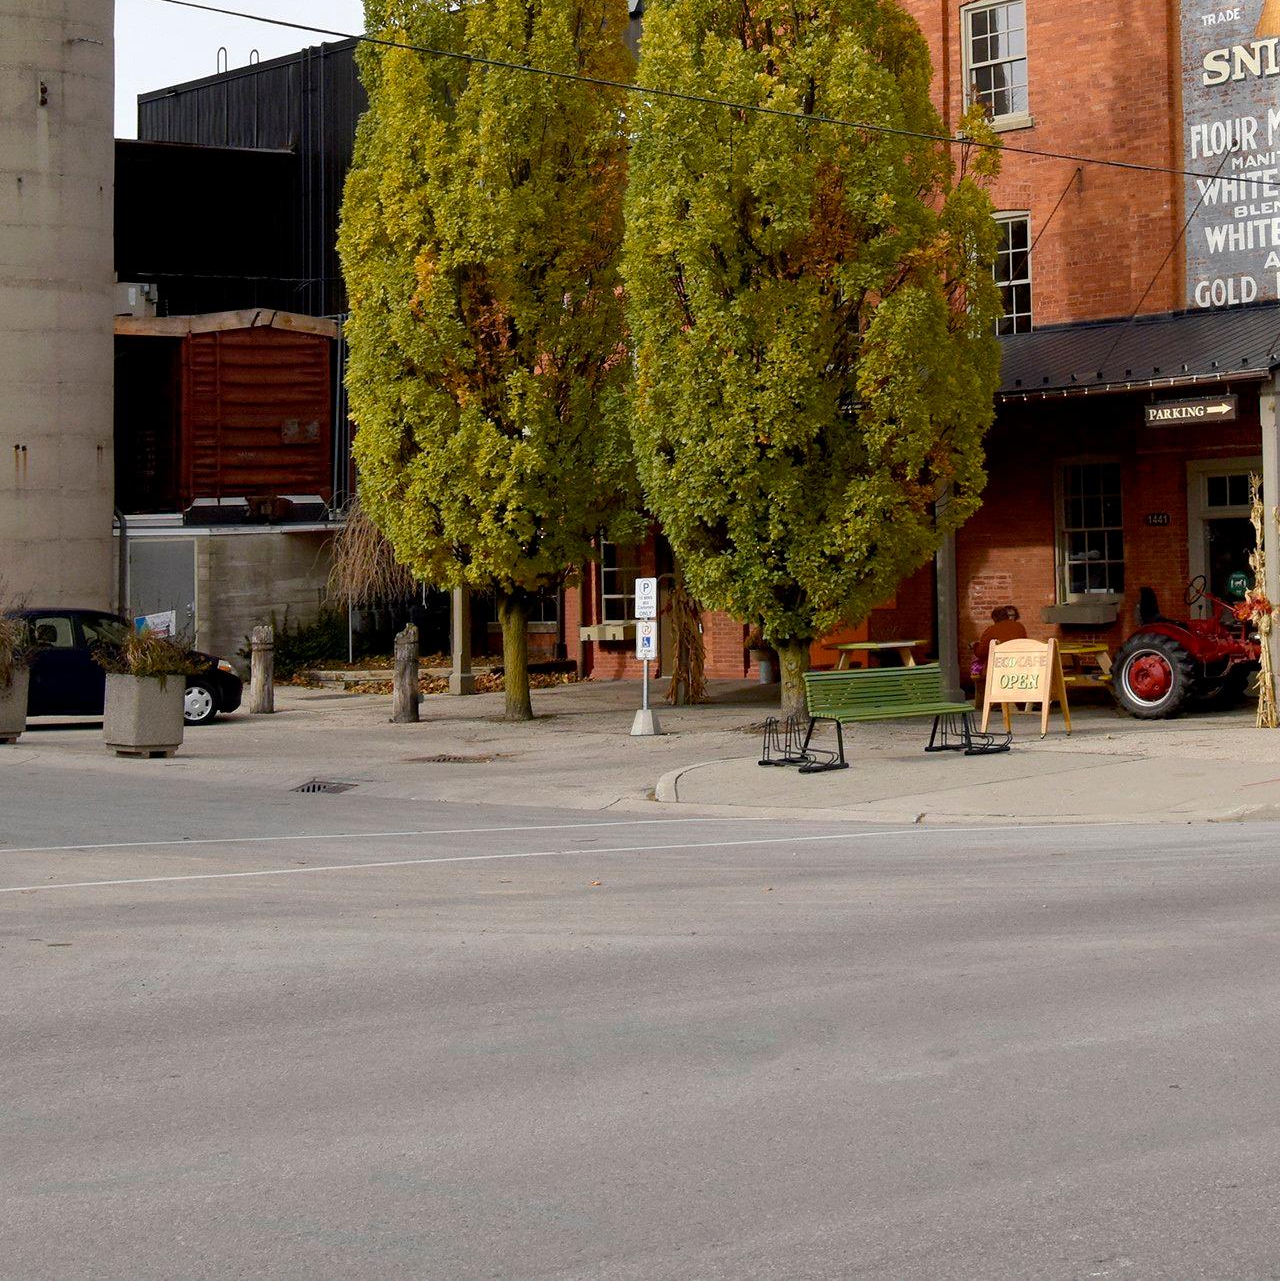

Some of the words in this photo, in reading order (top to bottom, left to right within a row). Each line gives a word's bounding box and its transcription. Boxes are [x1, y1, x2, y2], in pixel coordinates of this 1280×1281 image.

[1201, 7, 1242, 27] TRADE
[1190, 116, 1257, 160] FLOUR
[1196, 169, 1279, 206] WHITE
[1195, 277, 1257, 308] GOLD
[1148, 406, 1204, 420] PARKING
[643, 582, 650, 592] P
[1000, 674, 1039, 689] OPEN
